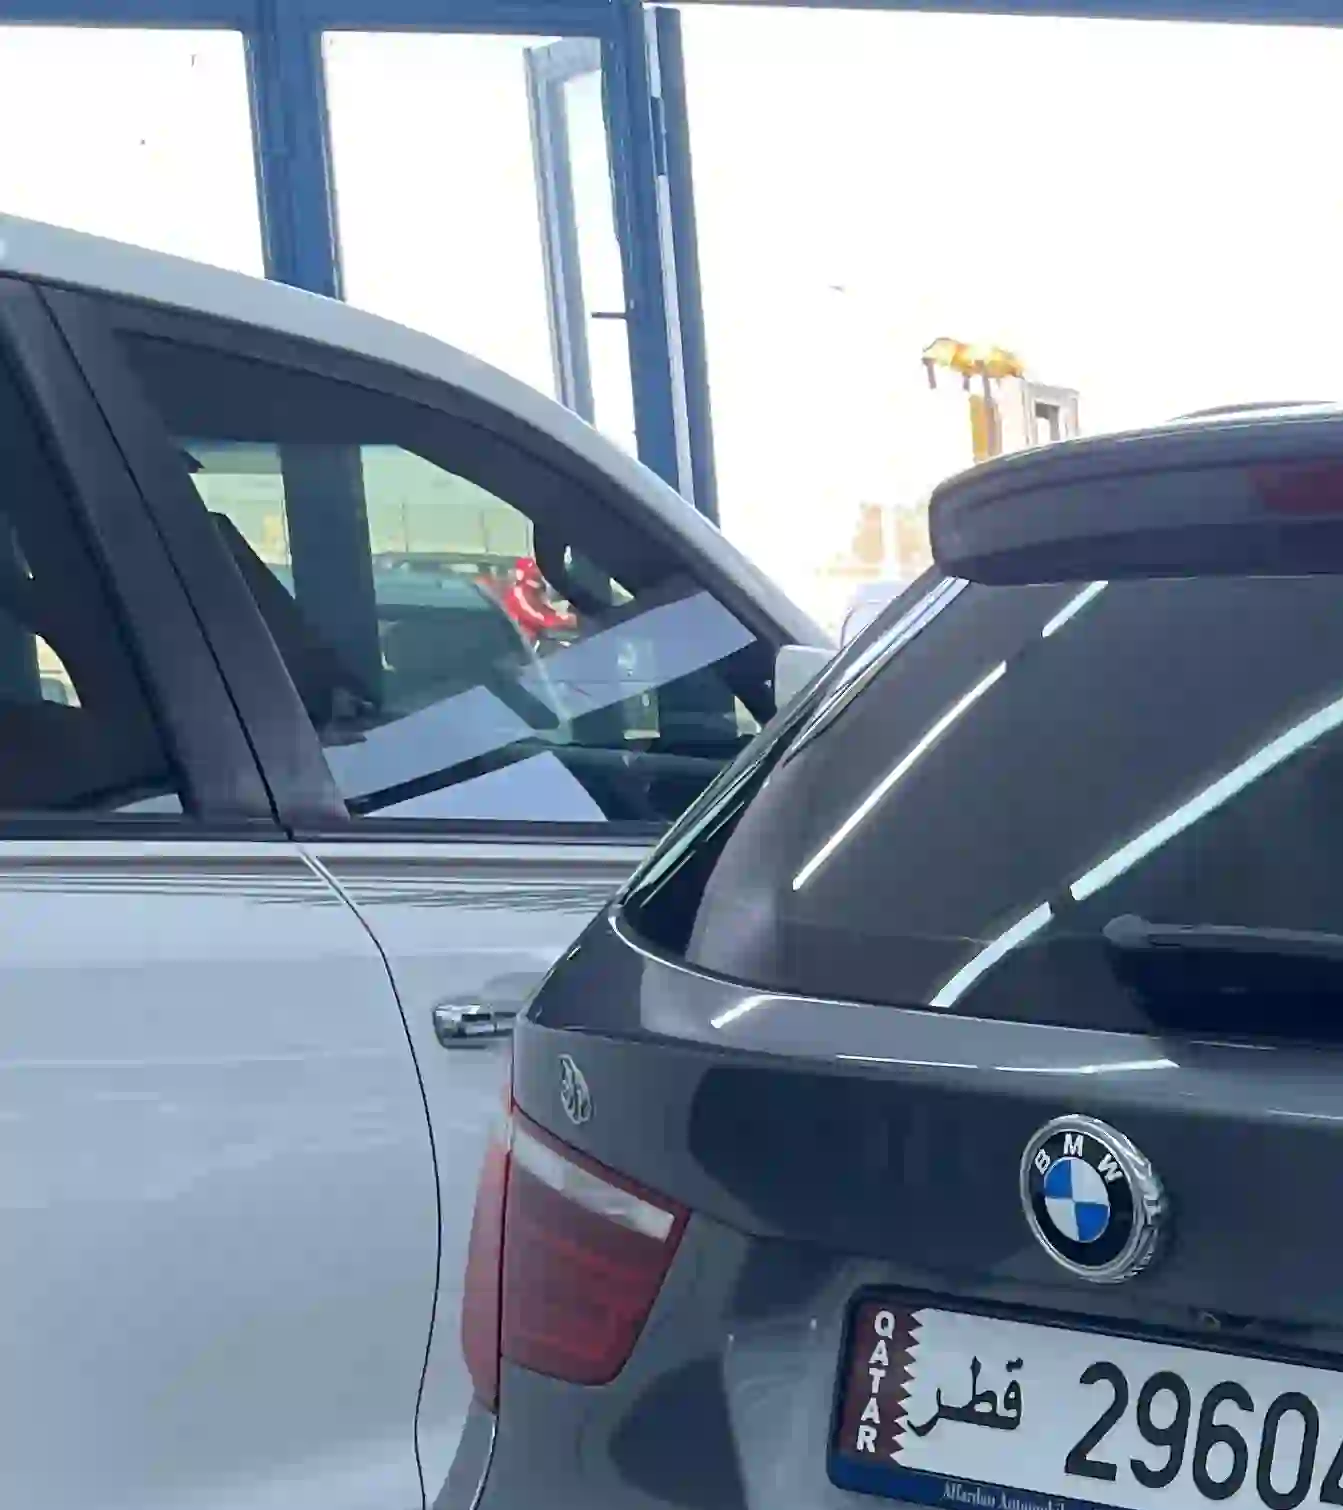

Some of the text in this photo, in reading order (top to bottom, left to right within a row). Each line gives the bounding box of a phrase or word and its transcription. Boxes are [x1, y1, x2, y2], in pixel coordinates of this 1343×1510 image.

[1034, 1132, 1124, 1184] BMW
[856, 1310, 896, 1453] QATAR
[907, 1355, 1024, 1437] قطر
